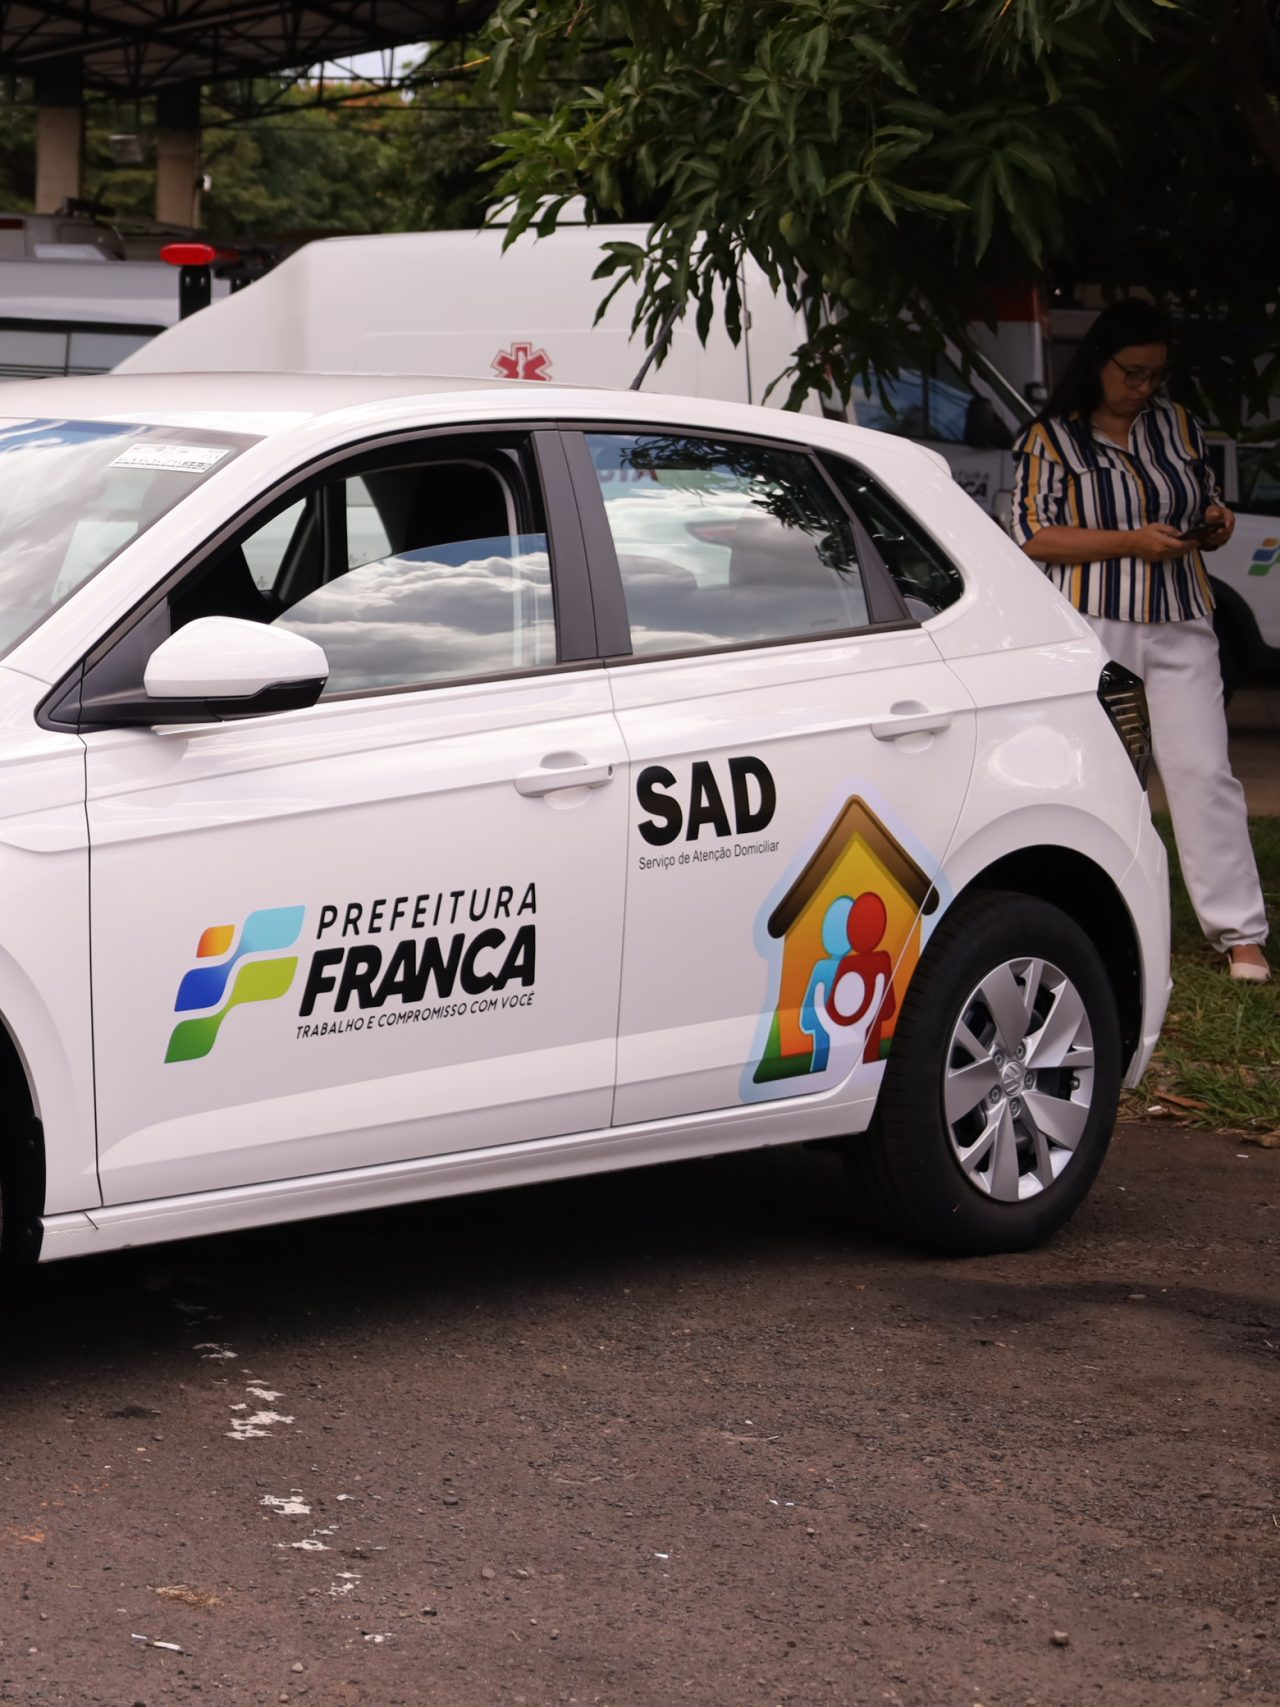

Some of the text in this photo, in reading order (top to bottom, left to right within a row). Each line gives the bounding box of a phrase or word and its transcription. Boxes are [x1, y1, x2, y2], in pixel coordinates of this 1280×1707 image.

[636, 755, 777, 846] SAD
[638, 840, 780, 870] Serviço de Atenção Domiciliar
[316, 882, 537, 940] PREFEITURA
[298, 924, 536, 1017] FRANCA
[296, 990, 536, 1040] TRABALHO E COMPROMISSO COM VOCÊ
